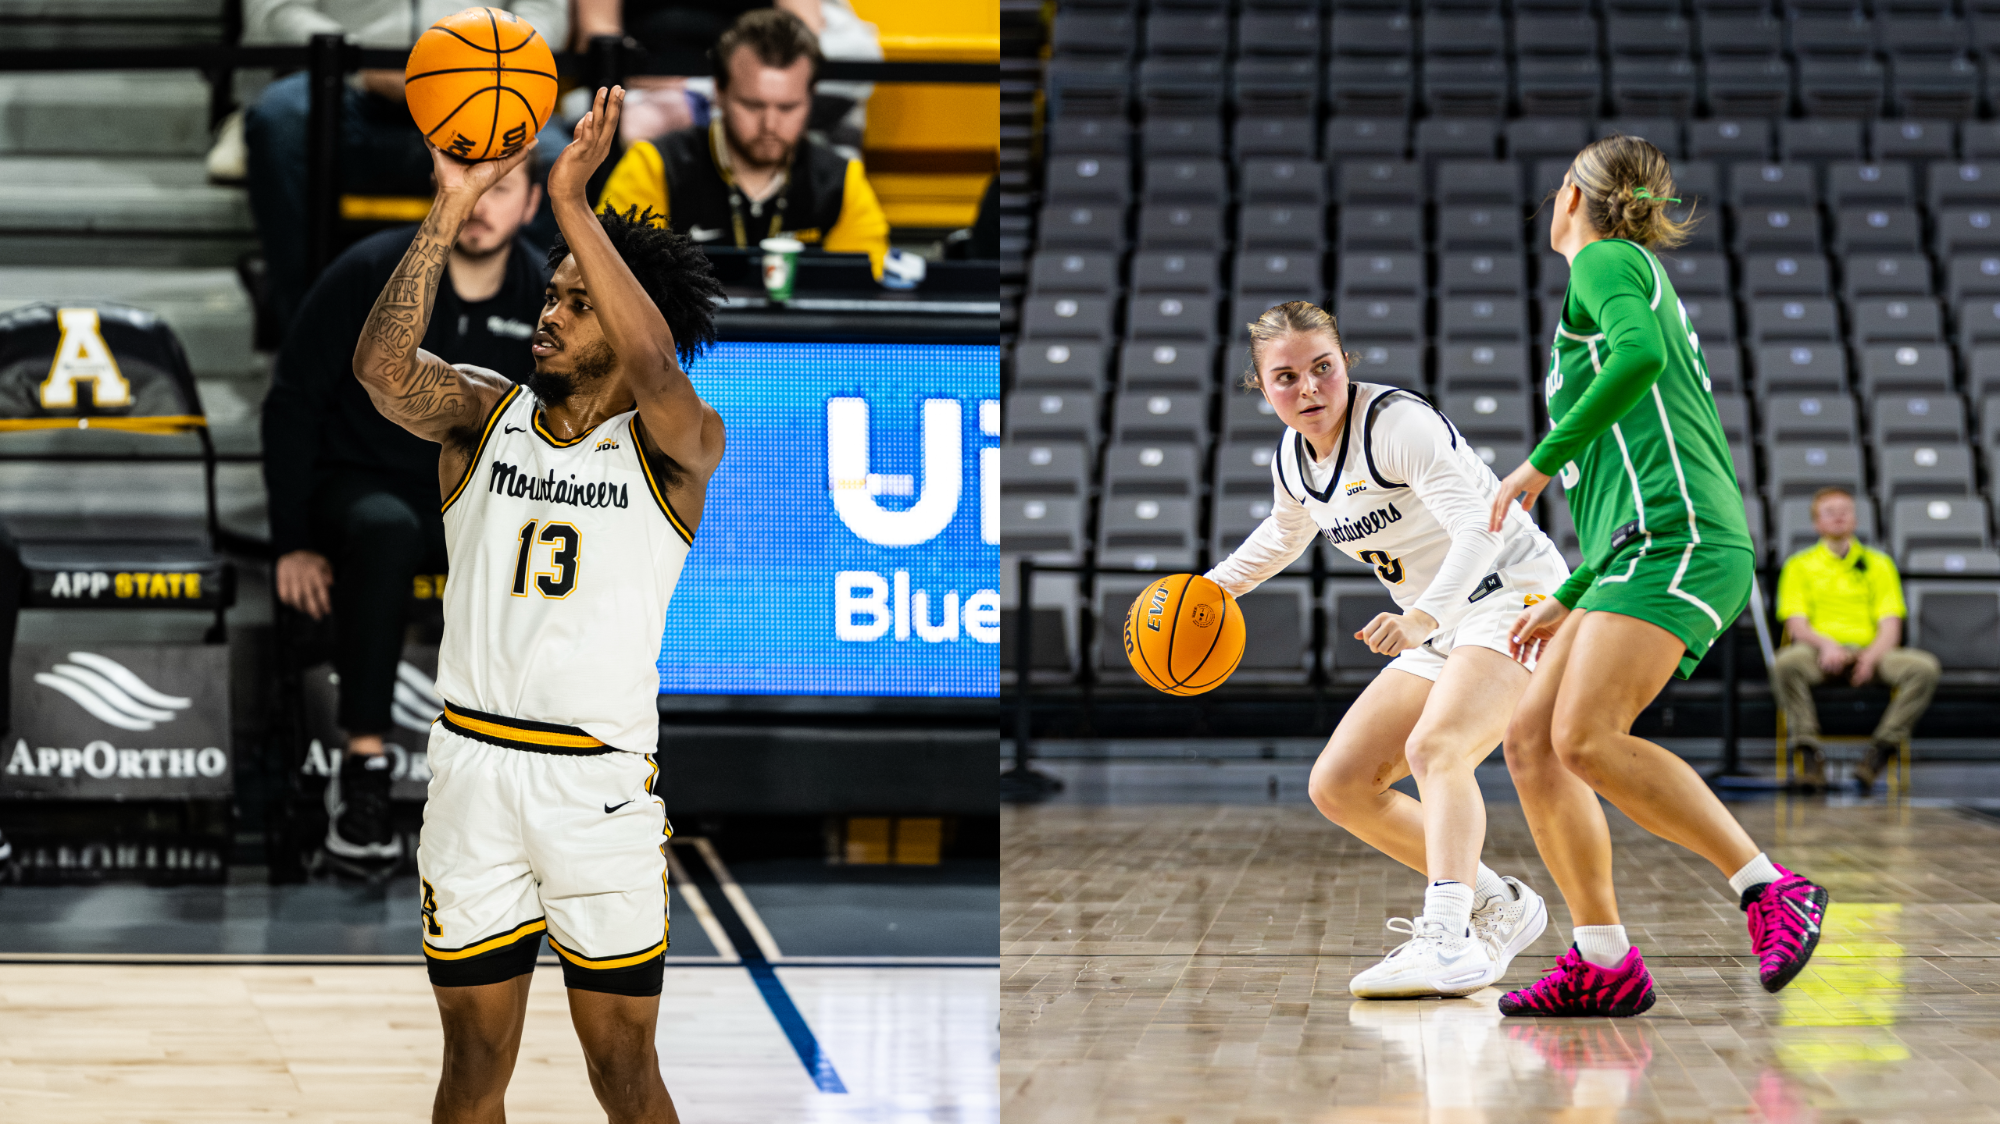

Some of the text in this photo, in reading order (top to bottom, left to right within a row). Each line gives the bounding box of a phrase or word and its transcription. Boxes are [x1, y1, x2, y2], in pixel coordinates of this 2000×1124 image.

[41, 308, 131, 408] A
[489, 461, 629, 509] Mountaineers
[51, 572, 201, 598] APP STATE
[510, 518, 582, 600] 13
[835, 570, 1000, 643] Blue
[1147, 587, 1169, 632] EVO
